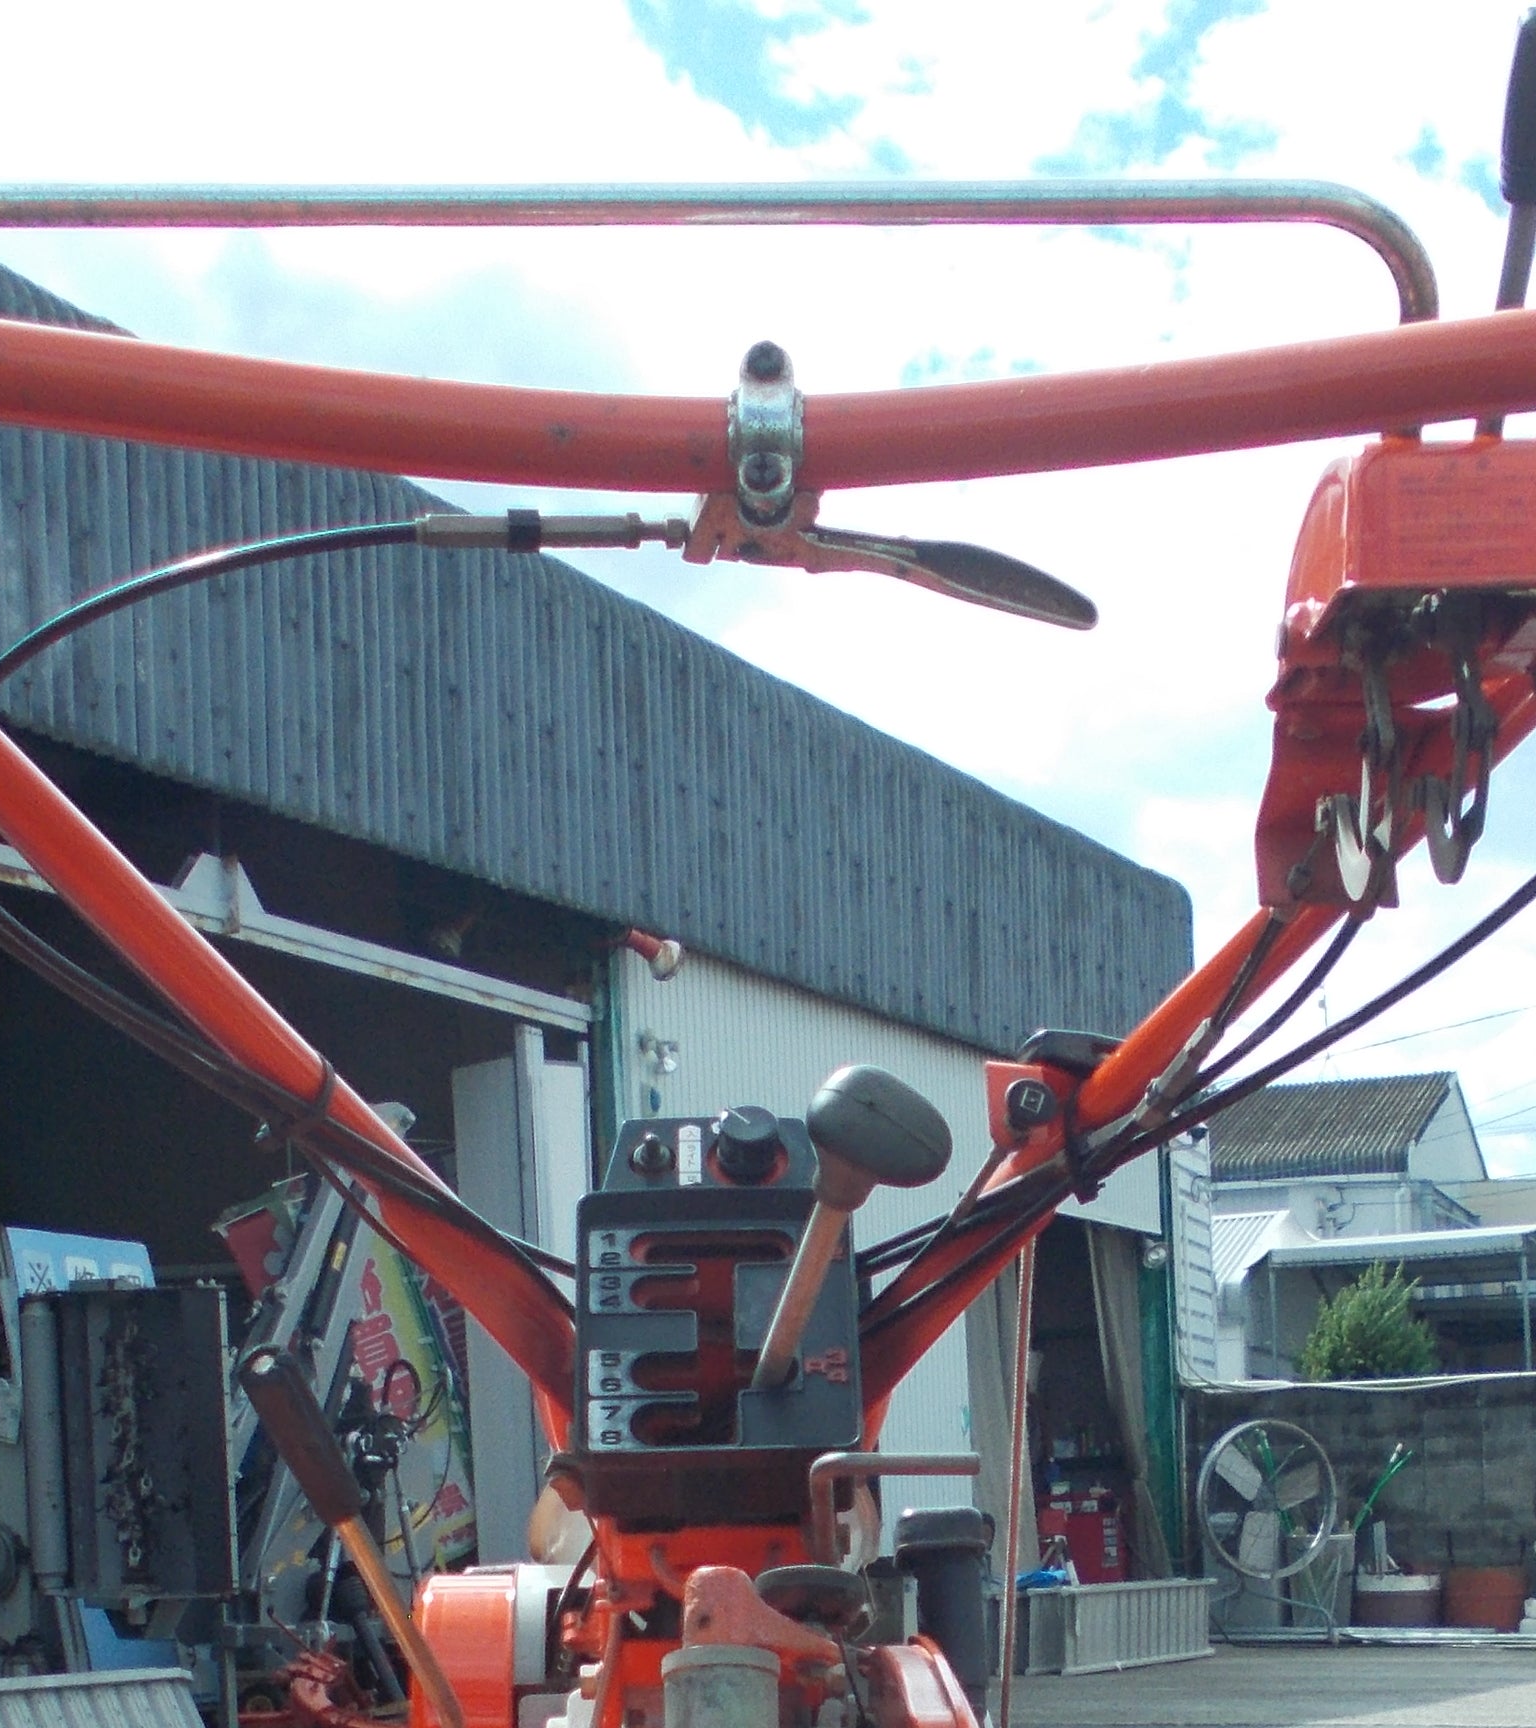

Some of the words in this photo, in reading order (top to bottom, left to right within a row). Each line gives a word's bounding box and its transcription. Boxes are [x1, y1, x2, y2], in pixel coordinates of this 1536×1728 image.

[601, 1233, 615, 1247] 1
[600, 1251, 621, 1266] 2
[600, 1276, 621, 1291] 3
[600, 1295, 621, 1308] 4
[600, 1352, 621, 1368] 5
[600, 1377, 621, 1393] 6
[600, 1405, 621, 1421] 7
[600, 1430, 621, 1446] 8
